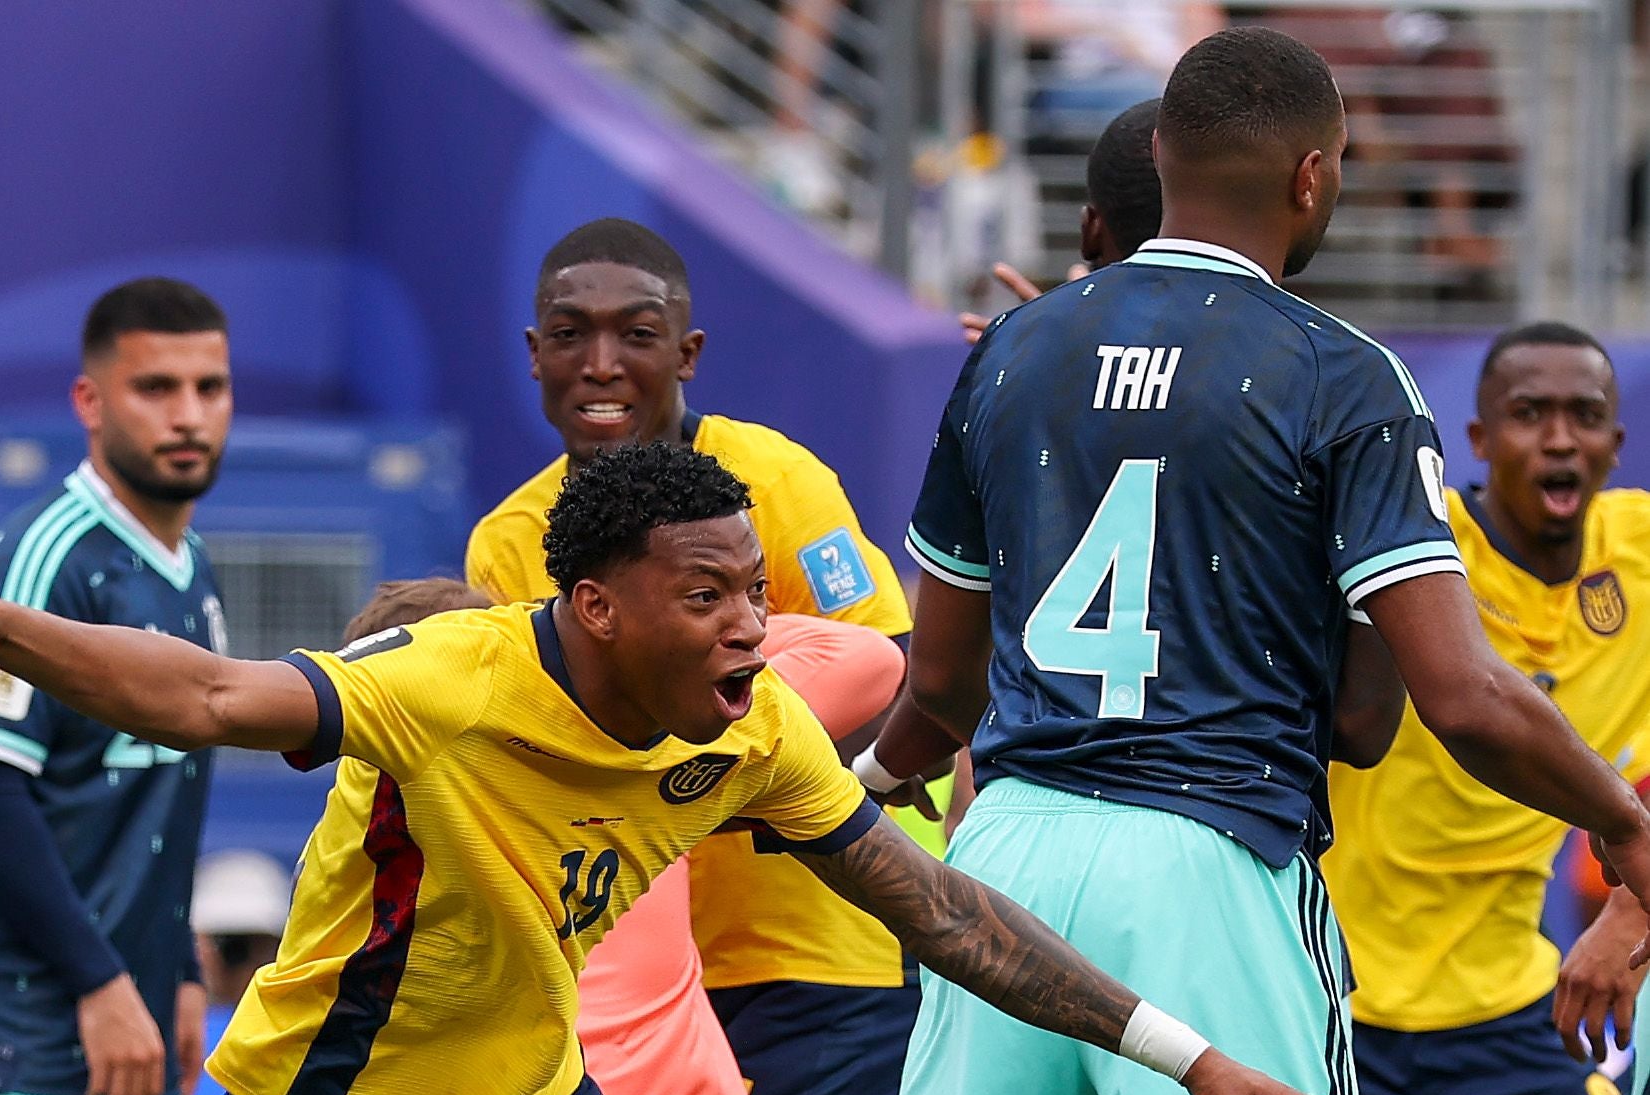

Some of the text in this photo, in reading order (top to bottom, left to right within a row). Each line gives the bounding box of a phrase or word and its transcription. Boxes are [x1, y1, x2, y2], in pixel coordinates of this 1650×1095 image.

[1092, 344, 1184, 410] TAH
[1024, 459, 1161, 720] 4
[557, 848, 619, 940] 19
